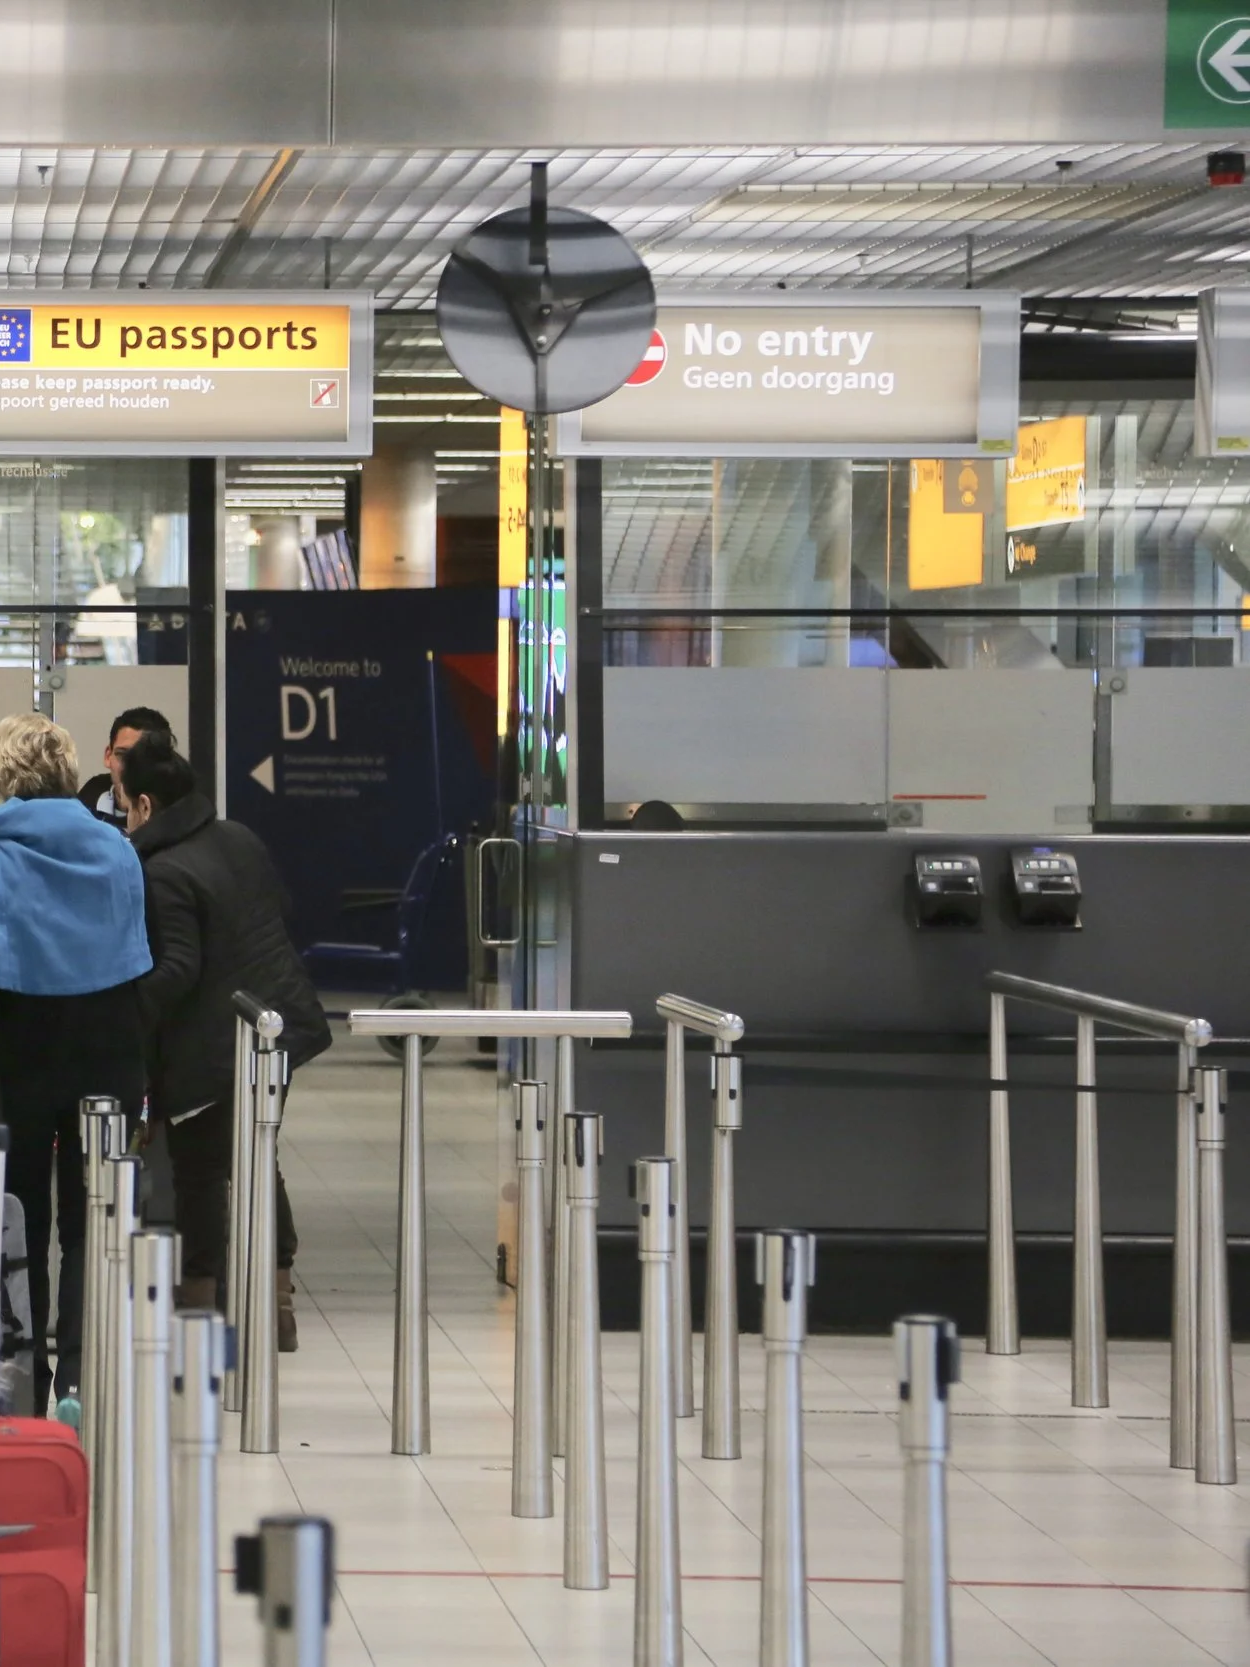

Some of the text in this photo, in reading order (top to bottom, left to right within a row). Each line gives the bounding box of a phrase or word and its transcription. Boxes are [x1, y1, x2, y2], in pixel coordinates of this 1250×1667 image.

[0, 324, 10, 332] EU
[51, 318, 317, 358] EU passports
[684, 323, 874, 365] No entry
[35, 374, 77, 392] keep
[83, 376, 157, 393] passport
[163, 375, 215, 393] ready.
[683, 365, 894, 395] Geen doorgang
[49, 394, 104, 411] gereed
[109, 394, 169, 408] houden
[280, 656, 382, 677] Welcome to
[281, 685, 337, 740] D1
